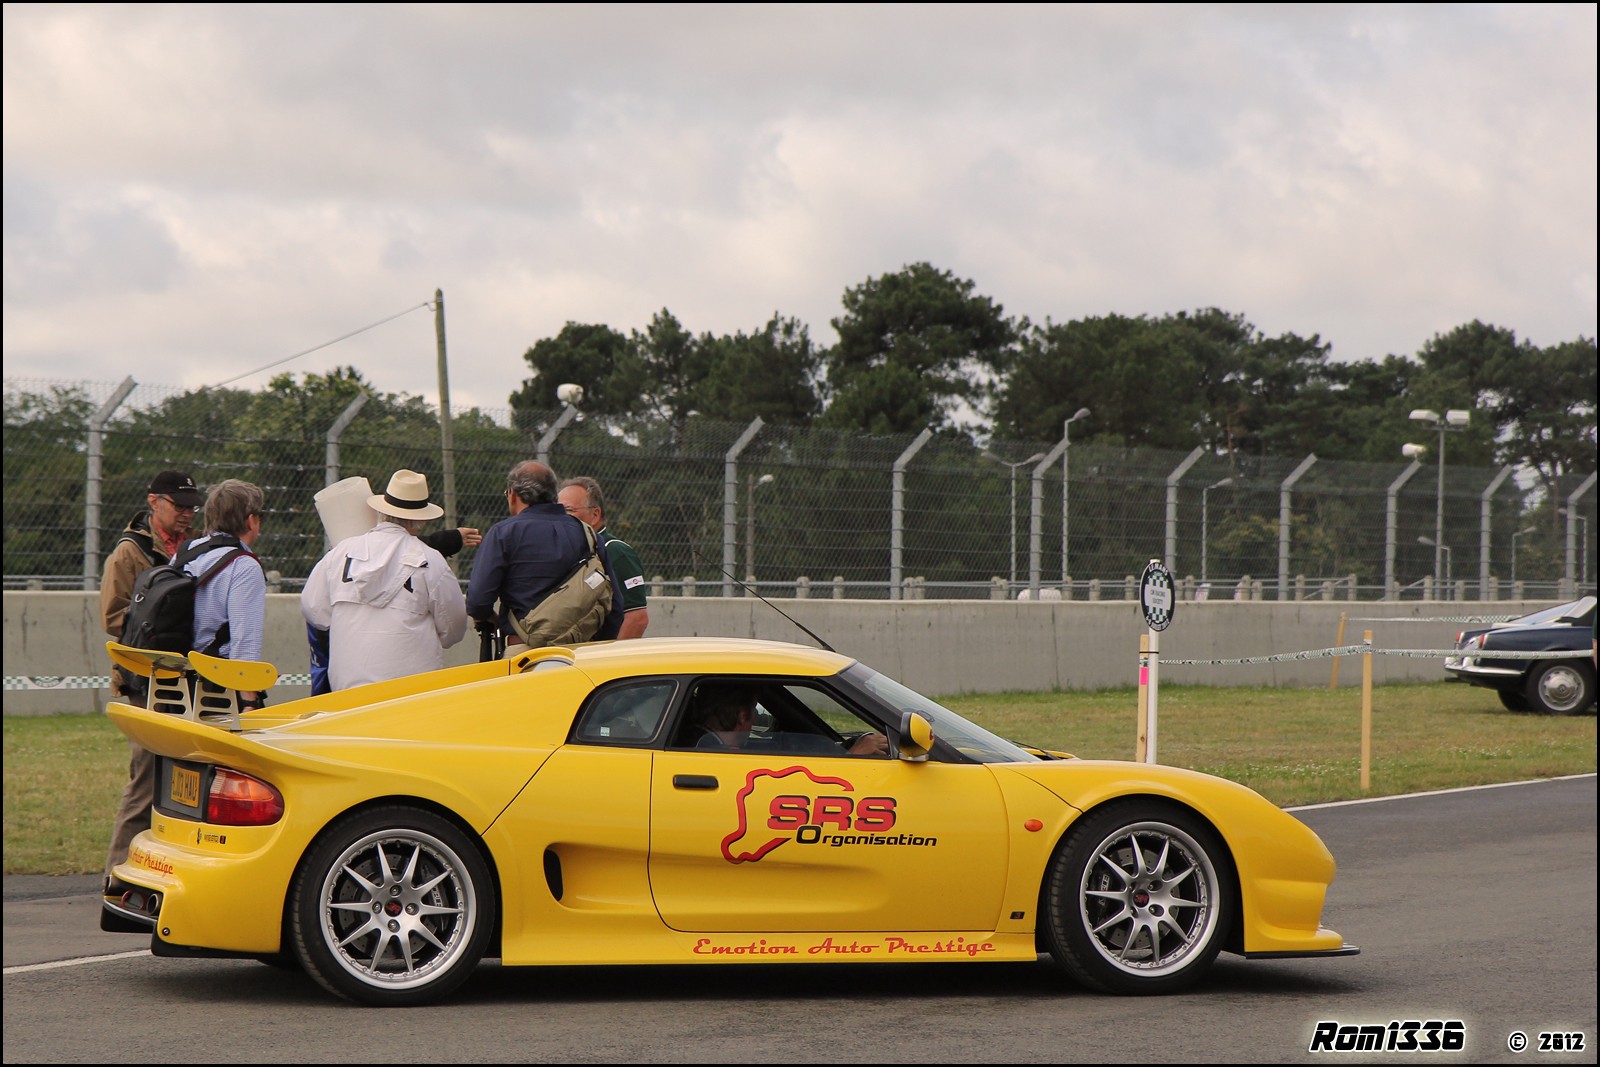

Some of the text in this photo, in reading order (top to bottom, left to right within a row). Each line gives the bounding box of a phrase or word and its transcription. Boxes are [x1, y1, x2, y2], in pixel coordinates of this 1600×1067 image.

[767, 795, 897, 832] SRS
[796, 825, 937, 847] Organisation
[143, 850, 174, 878] Prestige
[692, 937, 997, 957] Emotion Auto Prestige
